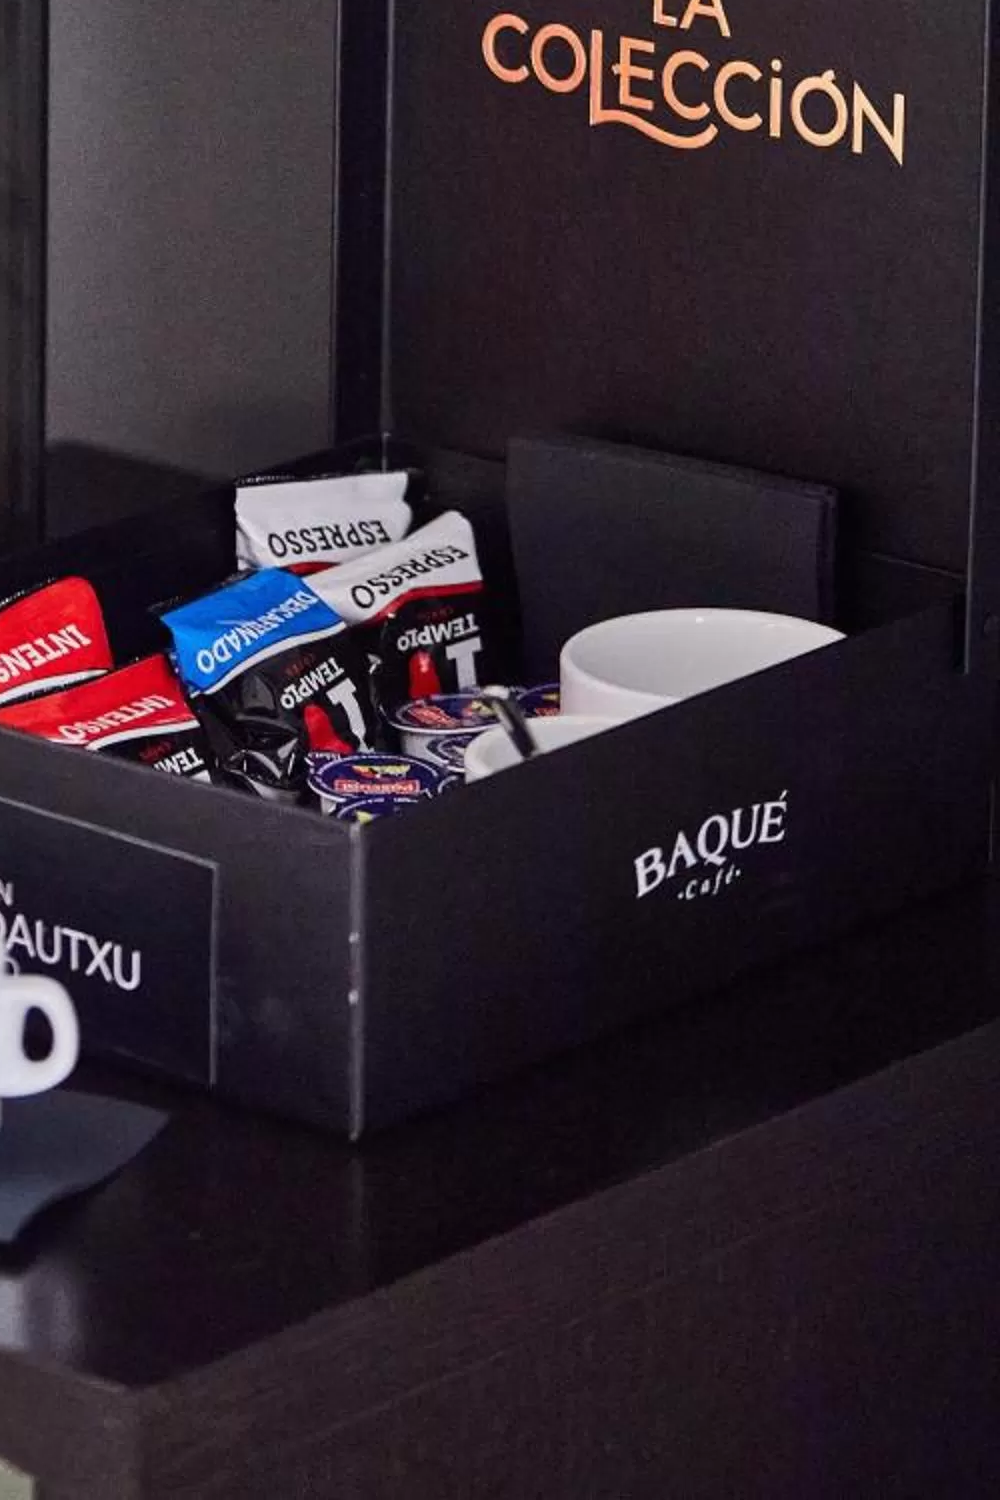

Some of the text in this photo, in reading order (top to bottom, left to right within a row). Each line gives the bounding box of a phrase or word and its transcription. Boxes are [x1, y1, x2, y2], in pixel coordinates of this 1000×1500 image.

[267, 519, 393, 559] ESPRESSO
[350, 544, 470, 610] ESPRESSO
[58, 693, 176, 743] INTENSO
[152, 747, 205, 773] TEM
[633, 789, 790, 899] BAQUÉ
